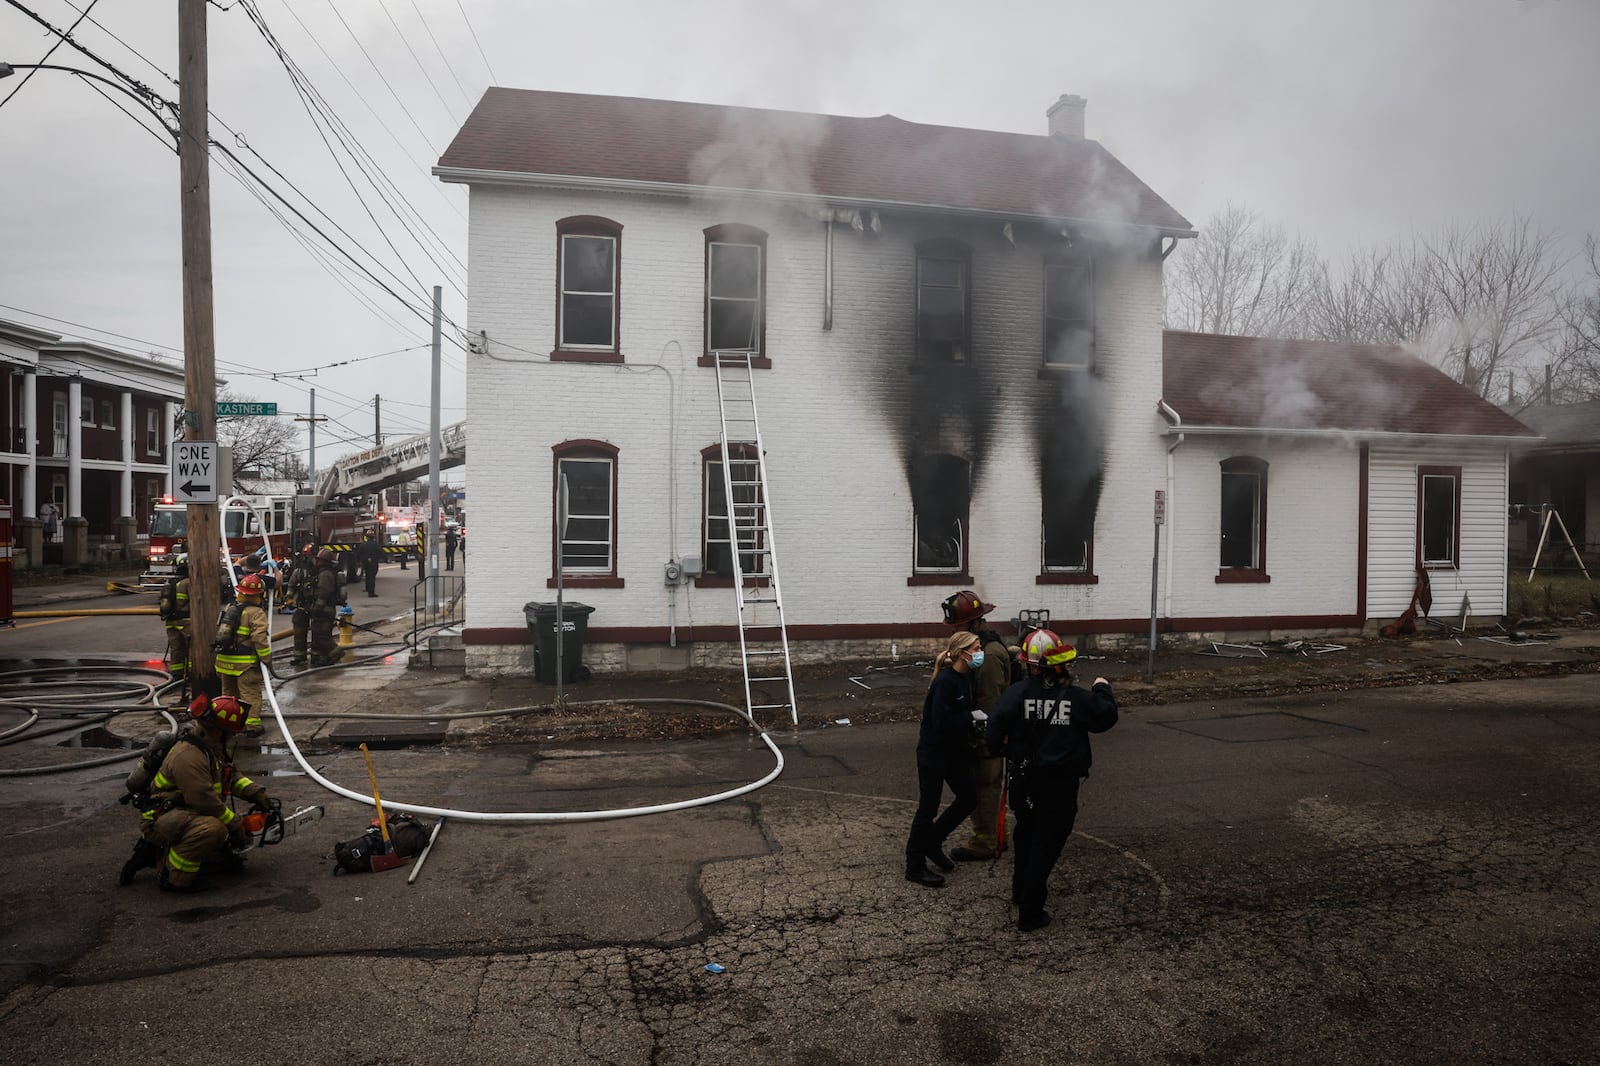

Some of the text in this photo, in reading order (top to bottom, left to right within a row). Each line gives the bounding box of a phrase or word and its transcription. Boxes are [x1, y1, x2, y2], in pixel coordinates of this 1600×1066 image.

[217, 404, 263, 414] KASTNER
[180, 446, 210, 460] ONE
[360, 451, 370, 461] FIRE
[179, 463, 210, 476] WAY
[1024, 699, 1071, 720] FIRE
